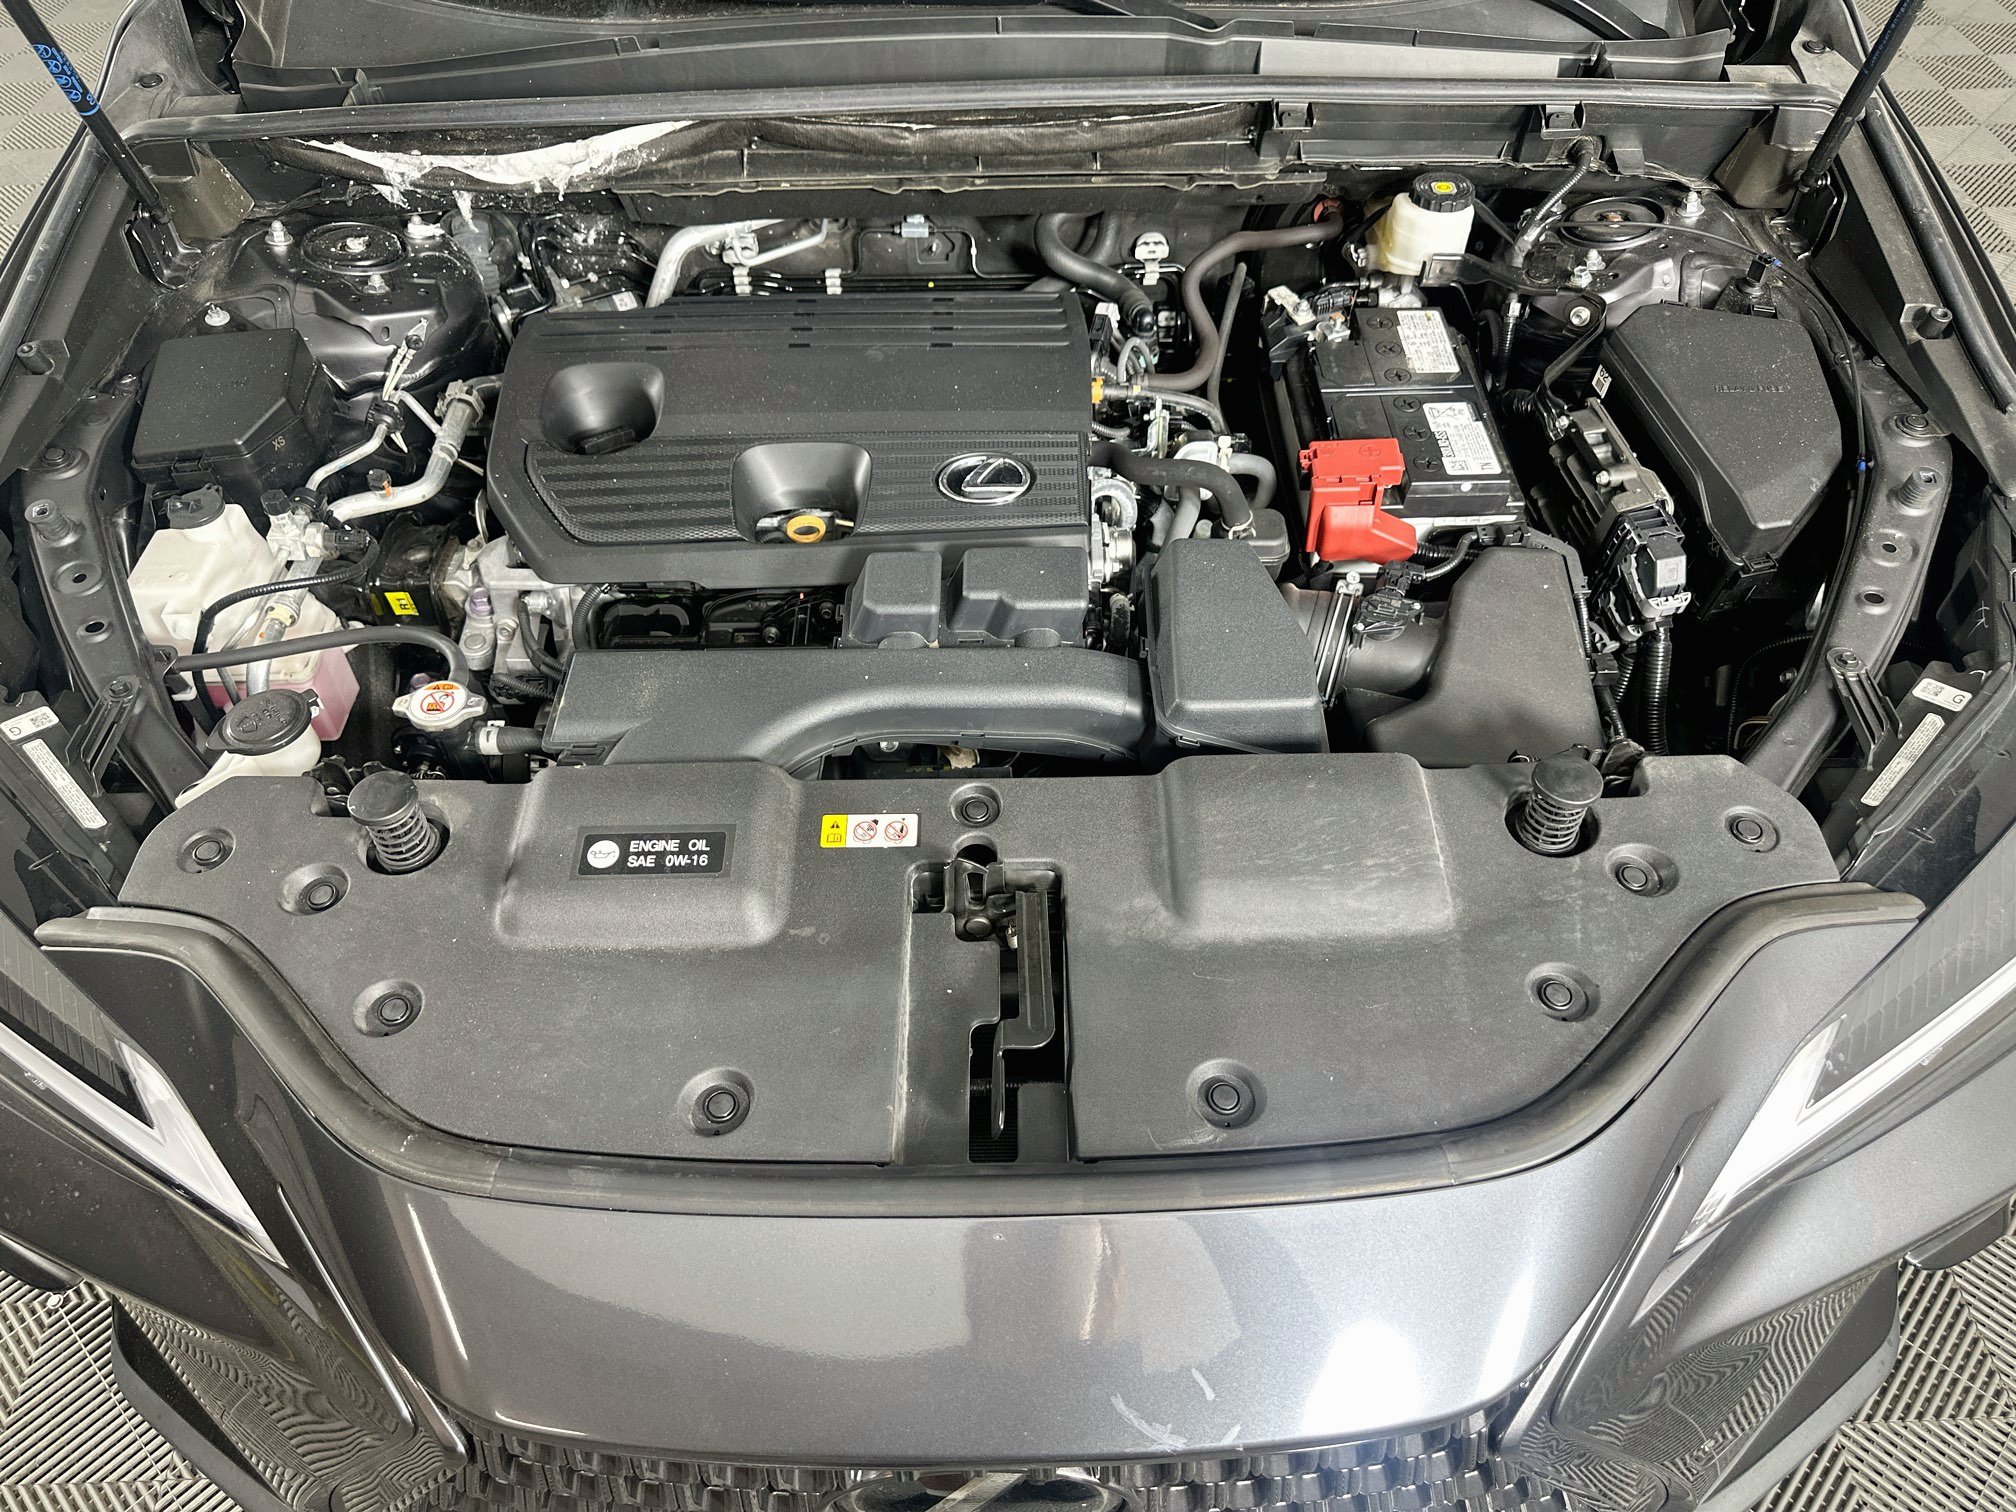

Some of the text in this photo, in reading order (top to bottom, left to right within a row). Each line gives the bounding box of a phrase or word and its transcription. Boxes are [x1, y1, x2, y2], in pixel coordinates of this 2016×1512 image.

[396, 598, 410, 610] R1
[1953, 694, 1966, 705] G
[629, 839, 710, 852] ENGINE OIL
[627, 854, 709, 867] SAE 0W-16
